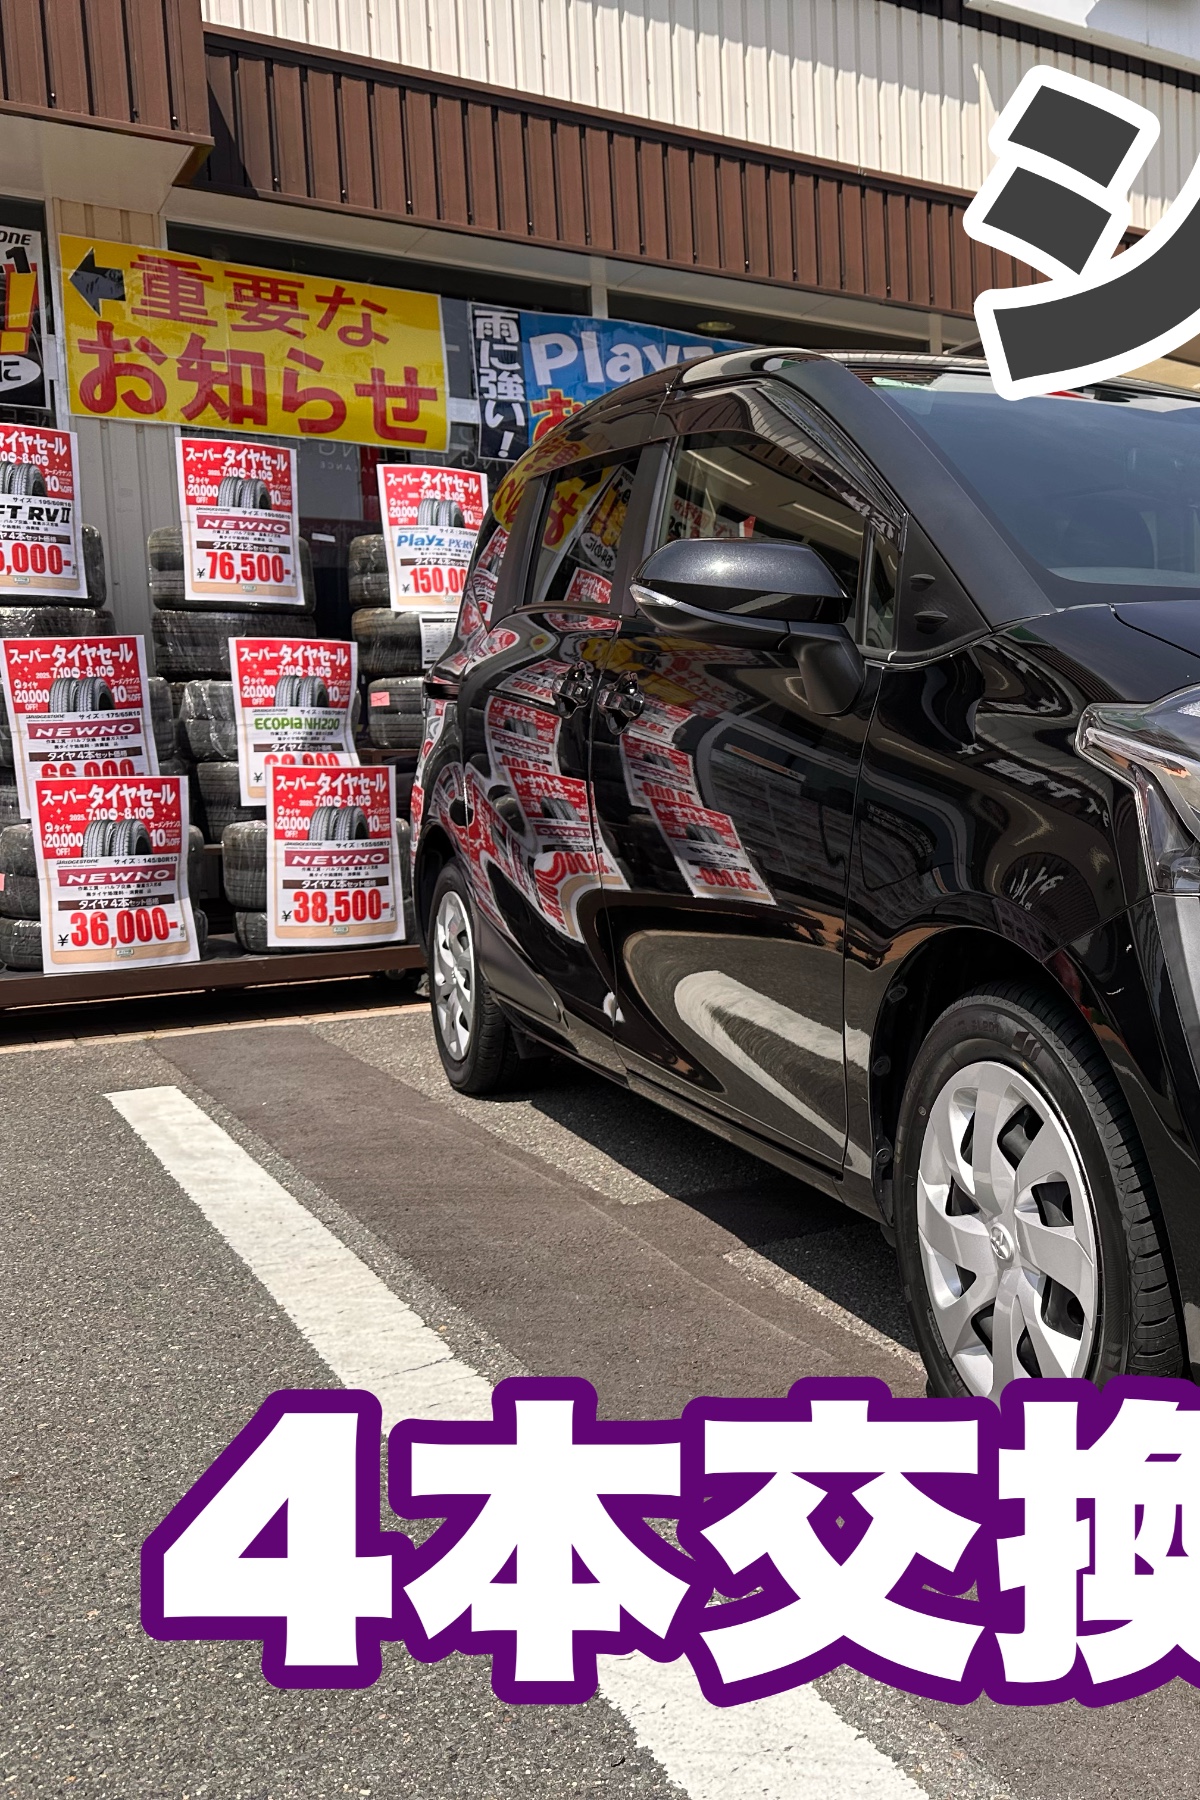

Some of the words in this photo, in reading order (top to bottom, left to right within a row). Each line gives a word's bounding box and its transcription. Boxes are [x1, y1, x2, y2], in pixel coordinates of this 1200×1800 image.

[129, 254, 391, 348] 重要な
[78, 321, 438, 443] お知らせ
[186, 446, 287, 471] スーパータイヤセール
[45, 475, 60, 492] 10
[387, 471, 479, 494] スーパータイヤセール
[269, 490, 280, 505] 10
[203, 519, 286, 532] NEWNO
[463, 510, 473, 525] 10
[397, 533, 445, 547] Playz
[9, 643, 133, 667] スーパータイヤセール
[240, 644, 348, 667] スーパータイヤセール
[111, 685, 126, 703] 10
[328, 686, 339, 702] 10
[36, 724, 135, 737] NEWNO
[304, 717, 339, 730] NH200
[276, 772, 386, 795] スーパータイヤセール
[41, 783, 176, 808] スーパータイヤセール
[367, 815, 380, 832] 10
[150, 829, 166, 847] 10
[292, 853, 385, 865] NEWNO
[67, 869, 170, 884] NEWNO
[57, 934, 69, 946] ¥
